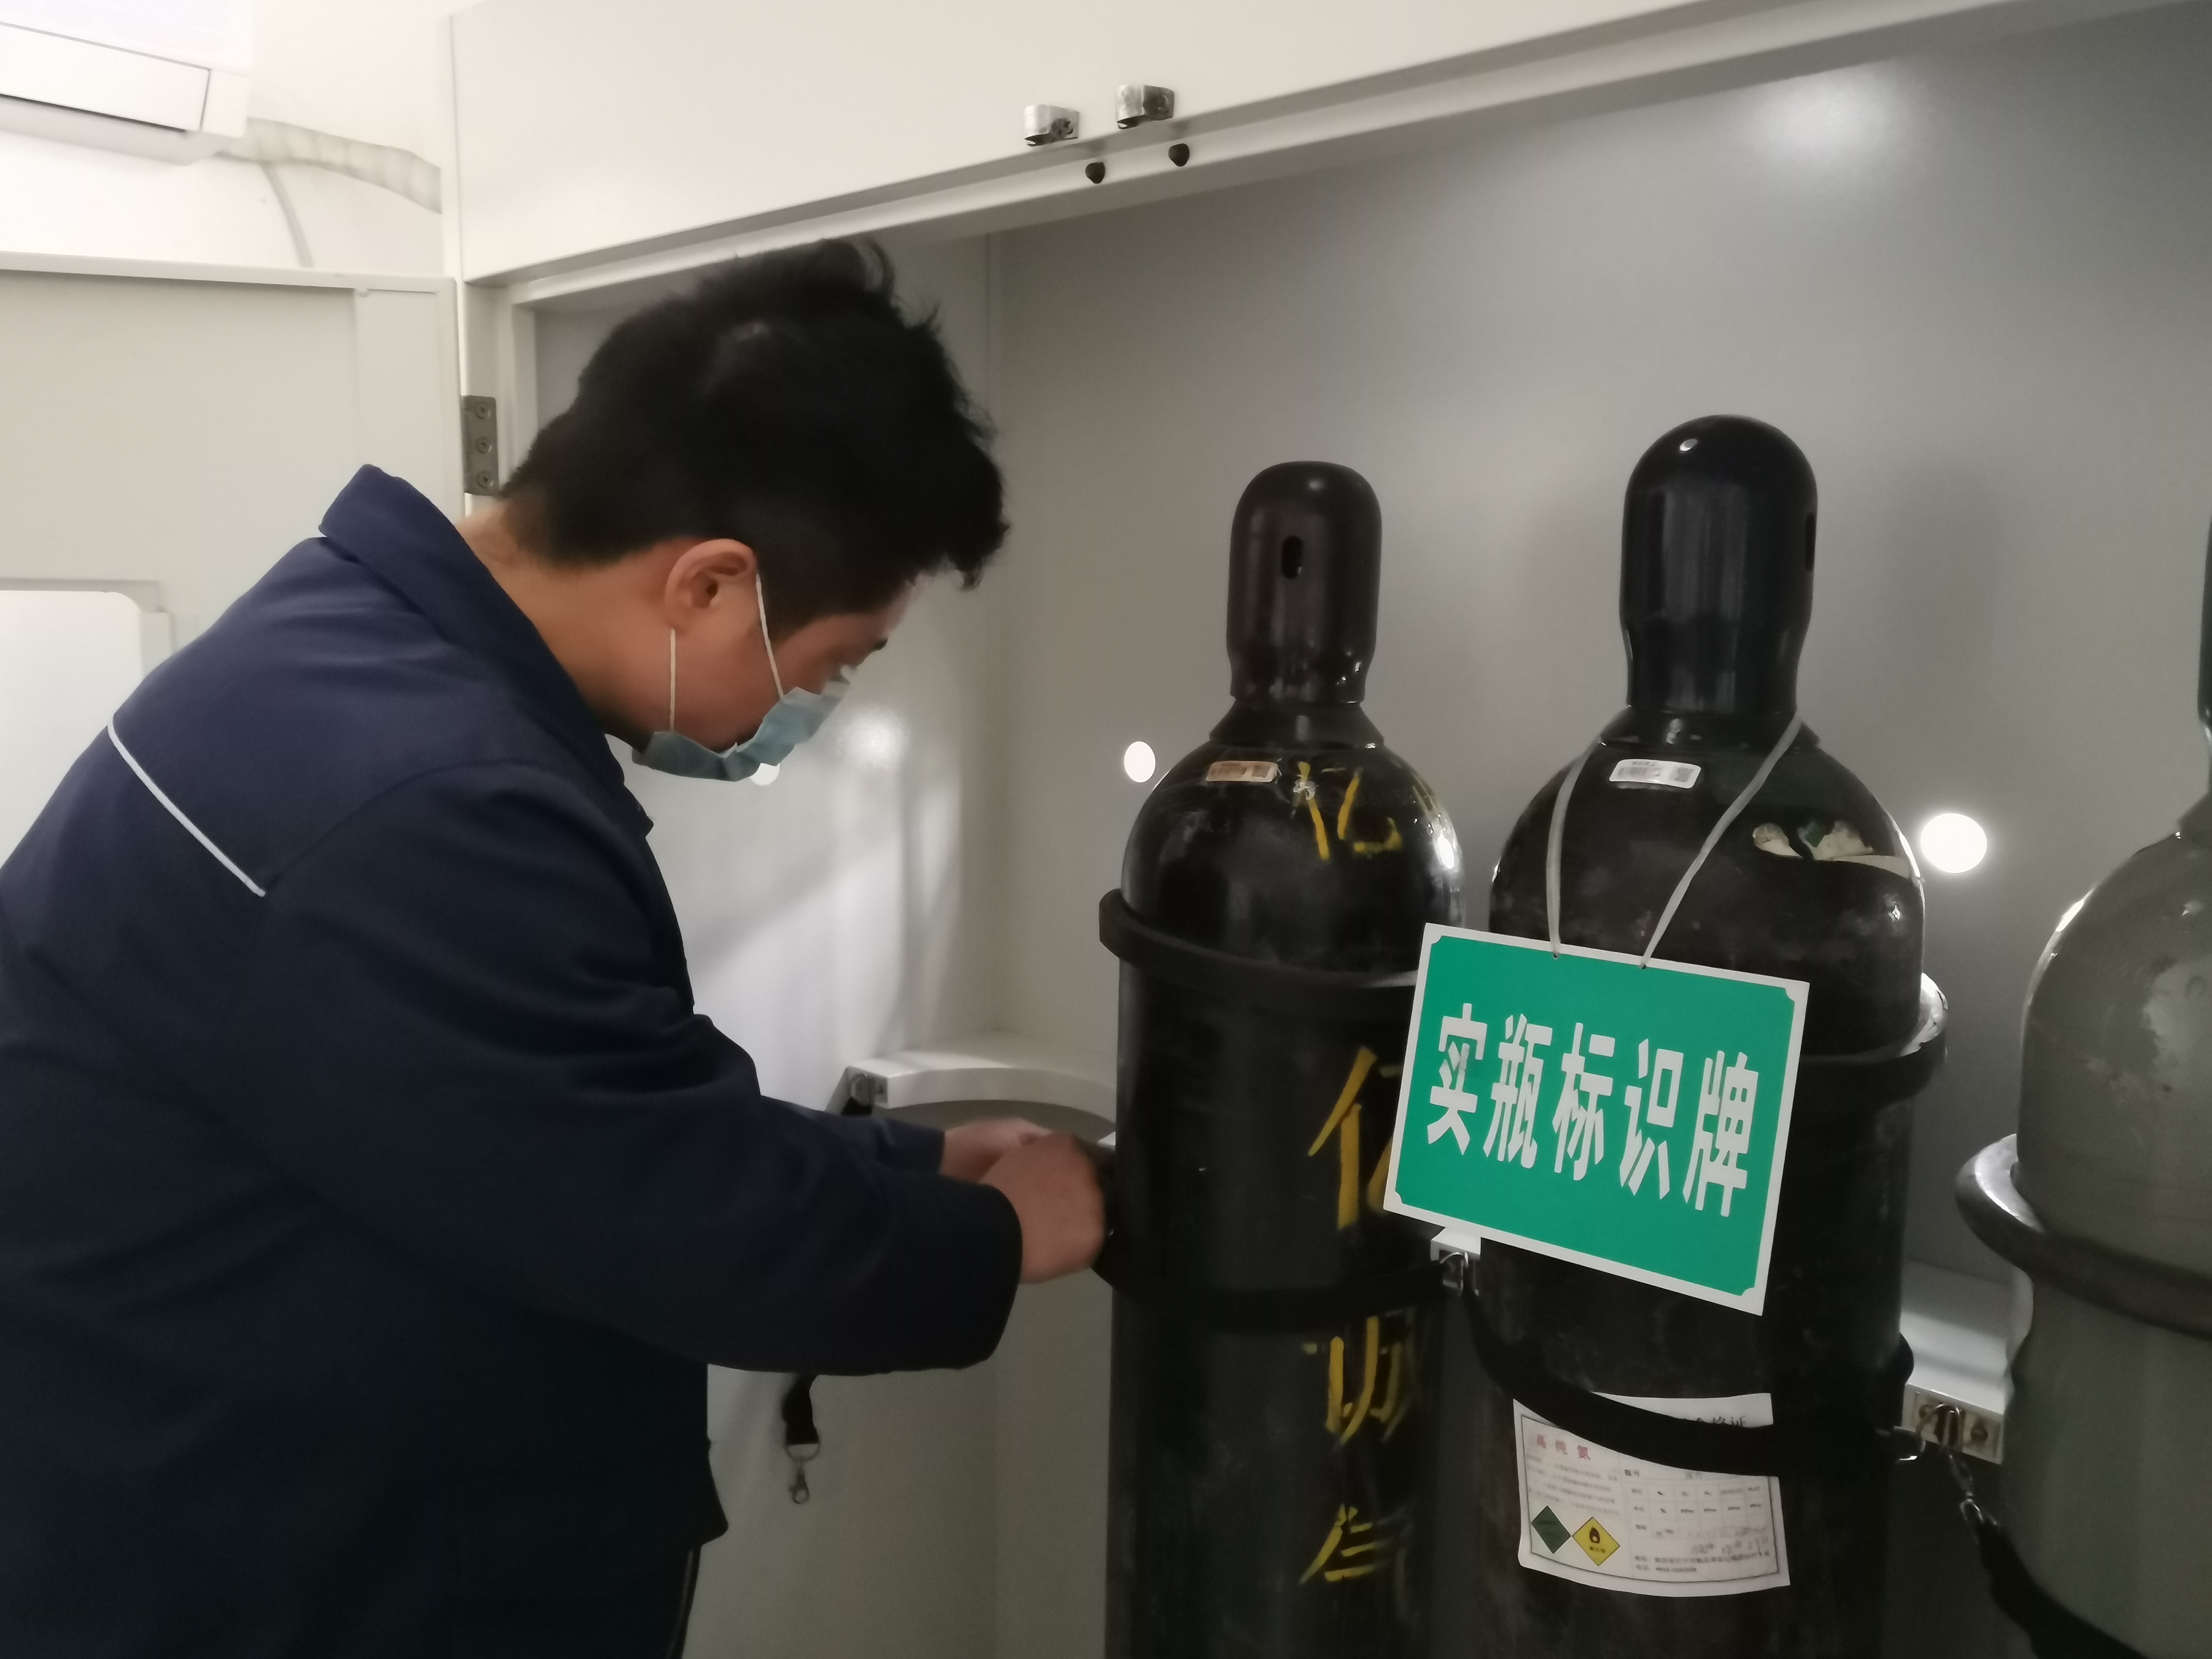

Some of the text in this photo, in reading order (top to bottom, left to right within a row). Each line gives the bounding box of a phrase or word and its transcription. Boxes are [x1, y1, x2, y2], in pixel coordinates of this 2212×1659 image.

[1427, 1002, 1759, 1217] 实瓶标识牌
